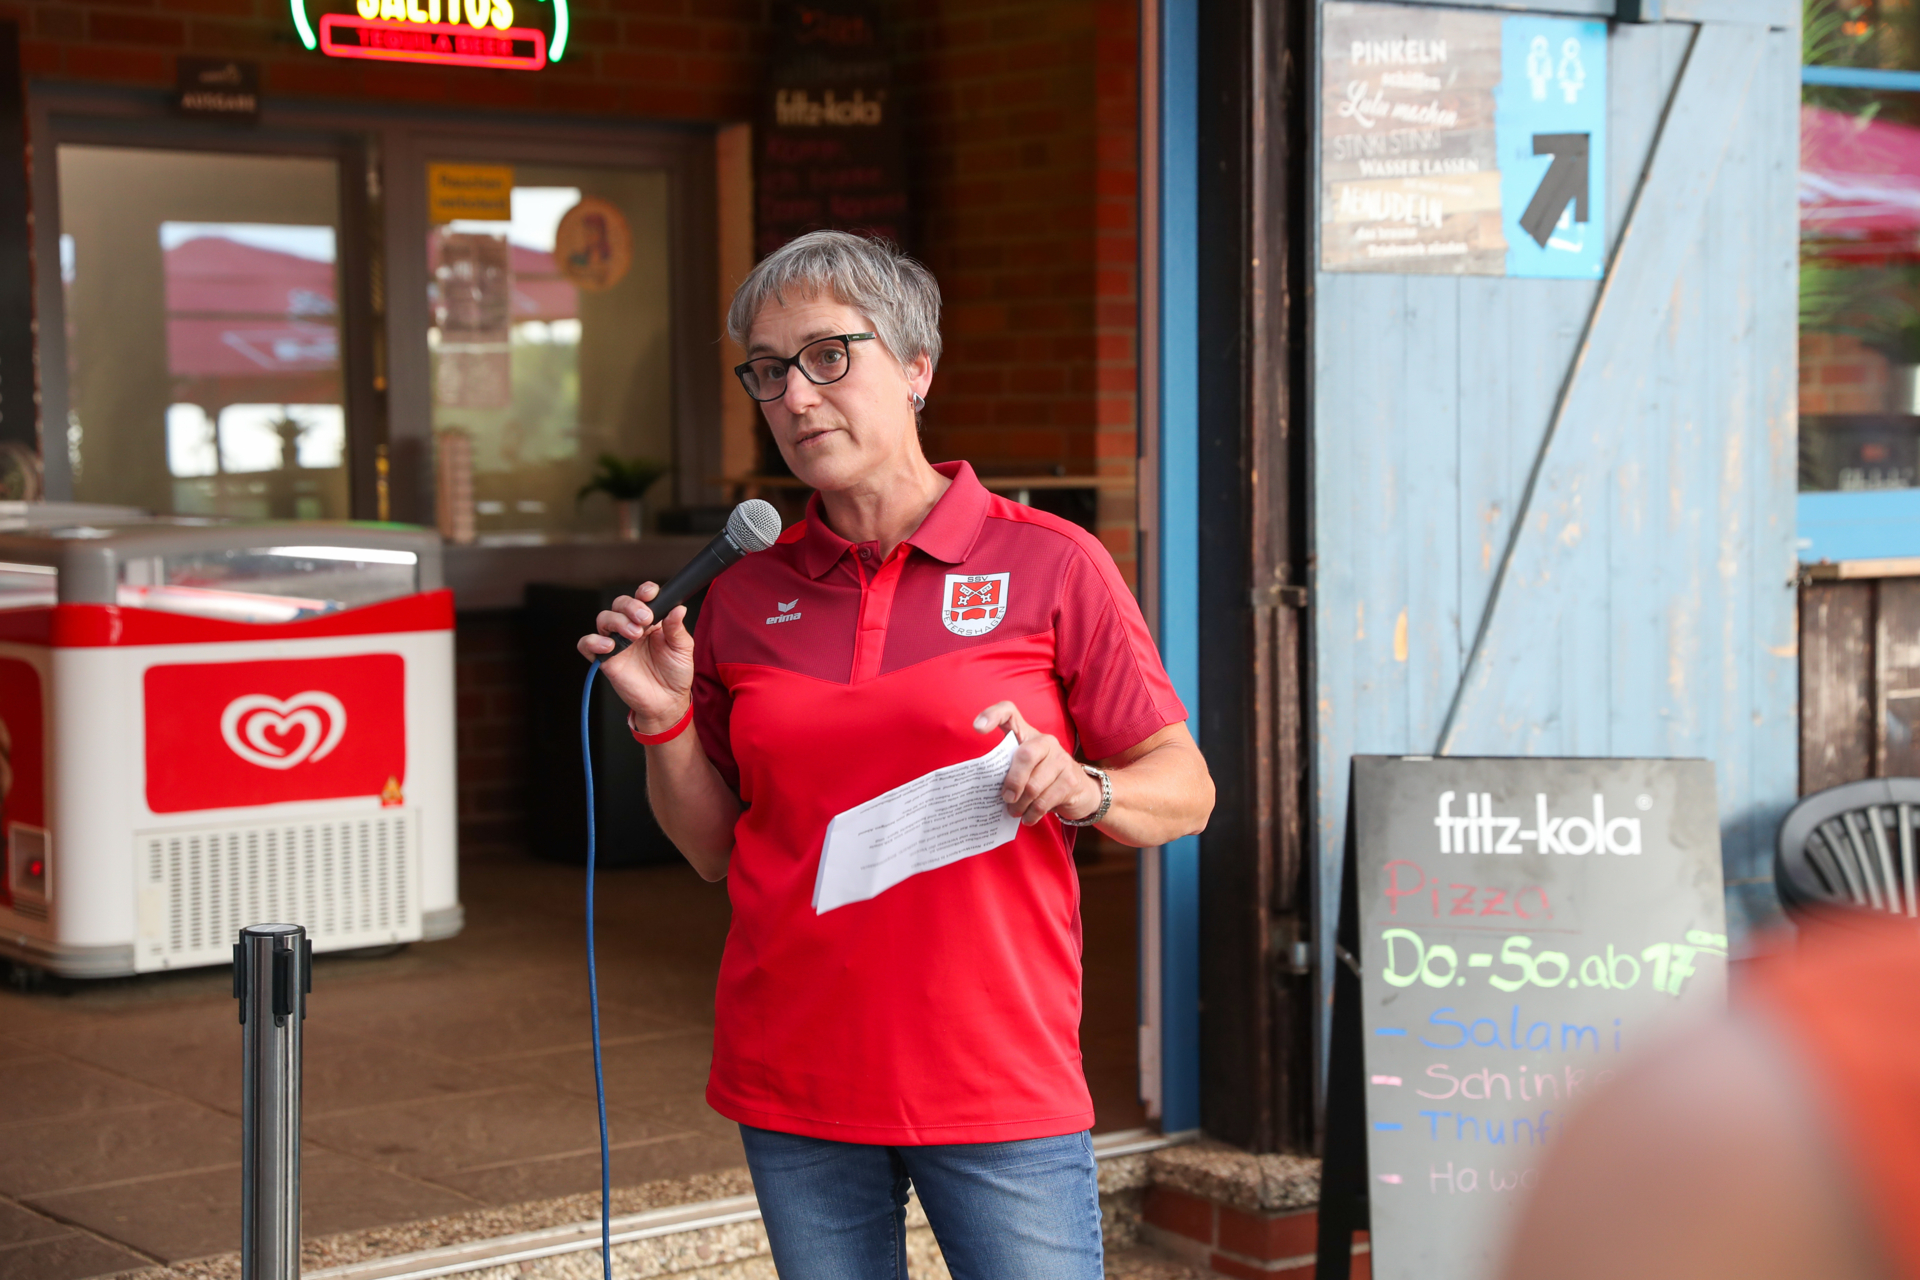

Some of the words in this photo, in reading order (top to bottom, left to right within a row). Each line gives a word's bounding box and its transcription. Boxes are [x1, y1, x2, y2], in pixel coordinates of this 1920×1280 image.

[1351, 39, 1448, 65] PINKELN
[1358, 158, 1421, 177] WASSER
[1423, 157, 1480, 175] LASSEN
[766, 611, 801, 625] erima
[944, 606, 1005, 635] PETERSHAGEN
[1434, 791, 1641, 856] fritz-kola
[1382, 859, 1554, 921] Pizza
[1418, 1005, 1622, 1052] Salami
[1415, 1063, 1617, 1101] Schinke
[1418, 1109, 1565, 1146] Thunfi
